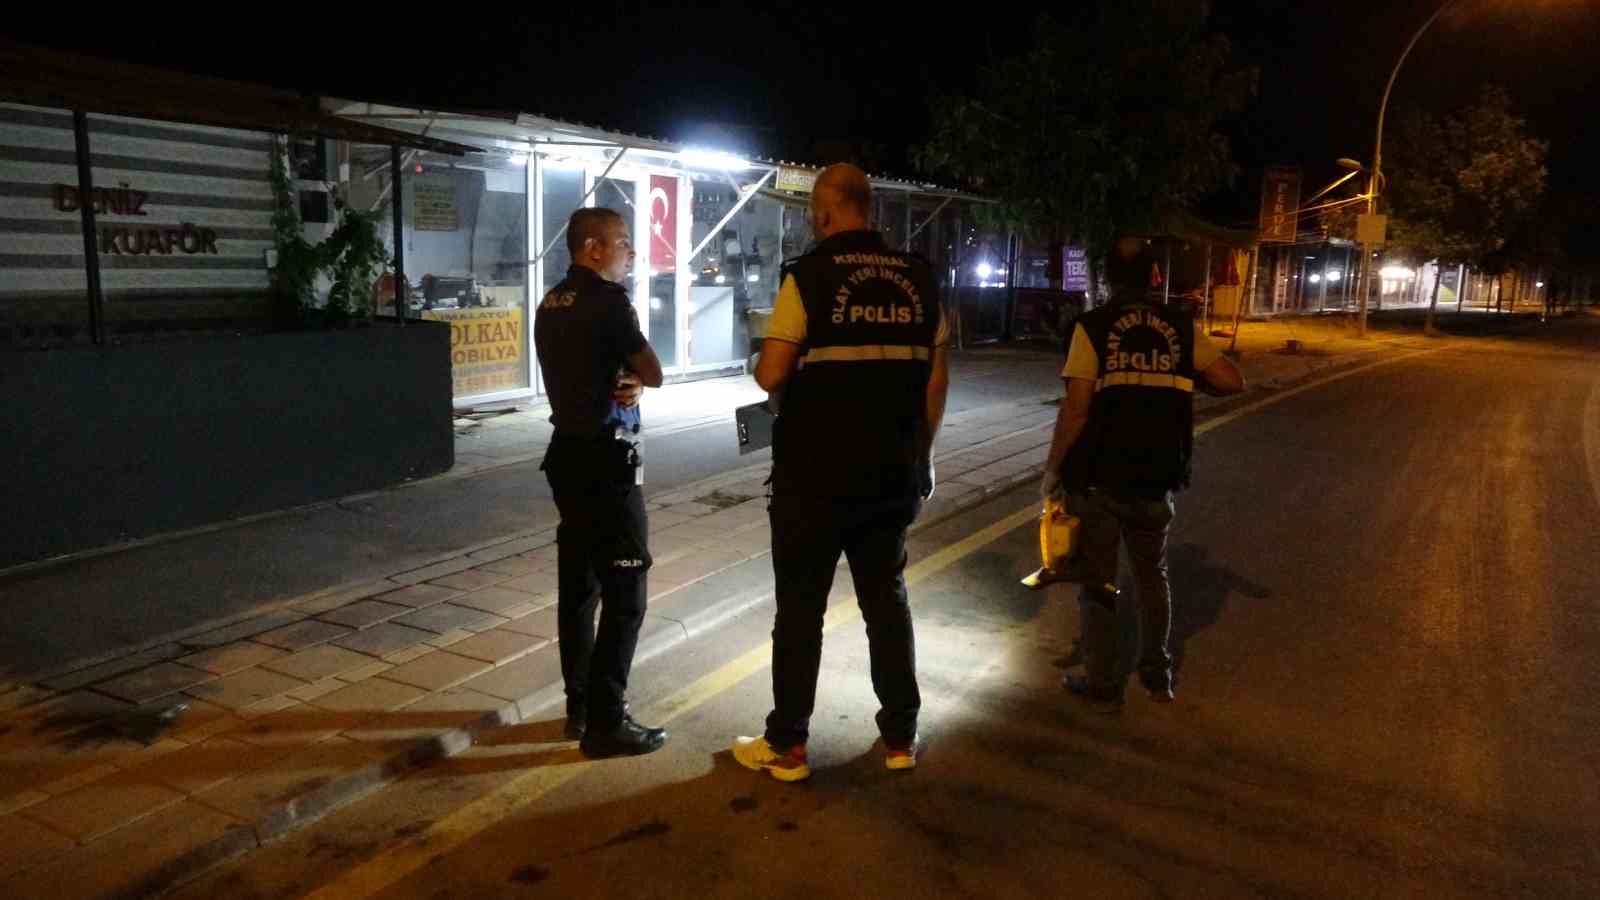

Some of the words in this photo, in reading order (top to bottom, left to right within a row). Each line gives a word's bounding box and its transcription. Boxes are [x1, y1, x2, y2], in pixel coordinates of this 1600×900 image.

[832, 253, 908, 267] KRİMİNAL
[832, 284, 851, 323] OLAY
[850, 302, 912, 323] POLİS
[452, 321, 518, 346] OLKAN
[1119, 347, 1170, 371] POLİS
